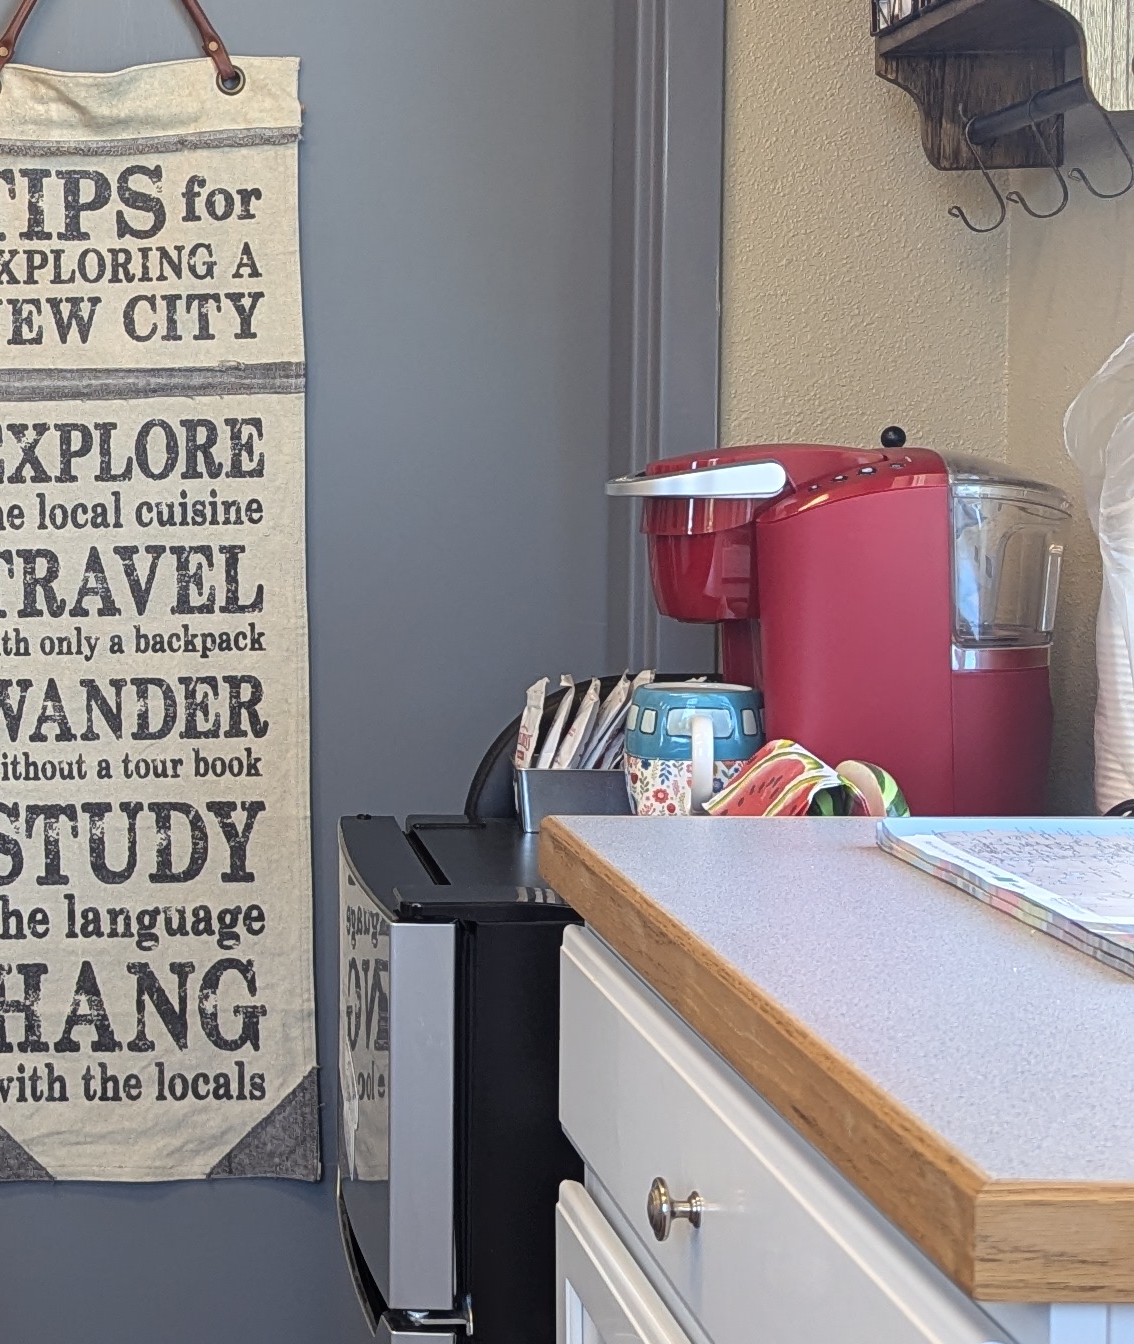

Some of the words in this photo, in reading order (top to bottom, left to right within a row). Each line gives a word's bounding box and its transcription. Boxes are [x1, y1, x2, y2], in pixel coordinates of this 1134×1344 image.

[181, 174, 263, 222] for
[232, 241, 263, 280] A
[122, 291, 265, 342] CITY
[36, 491, 121, 530] local
[135, 489, 264, 528] cuisine
[40, 627, 100, 661] only
[109, 635, 124, 654] a
[134, 623, 266, 658] backpack
[97, 759, 113, 780] a
[122, 754, 184, 780] tour
[193, 747, 263, 778] book
[65, 894, 266, 951] language
[81, 1062, 142, 1102] the
[155, 1061, 266, 1102] locals
